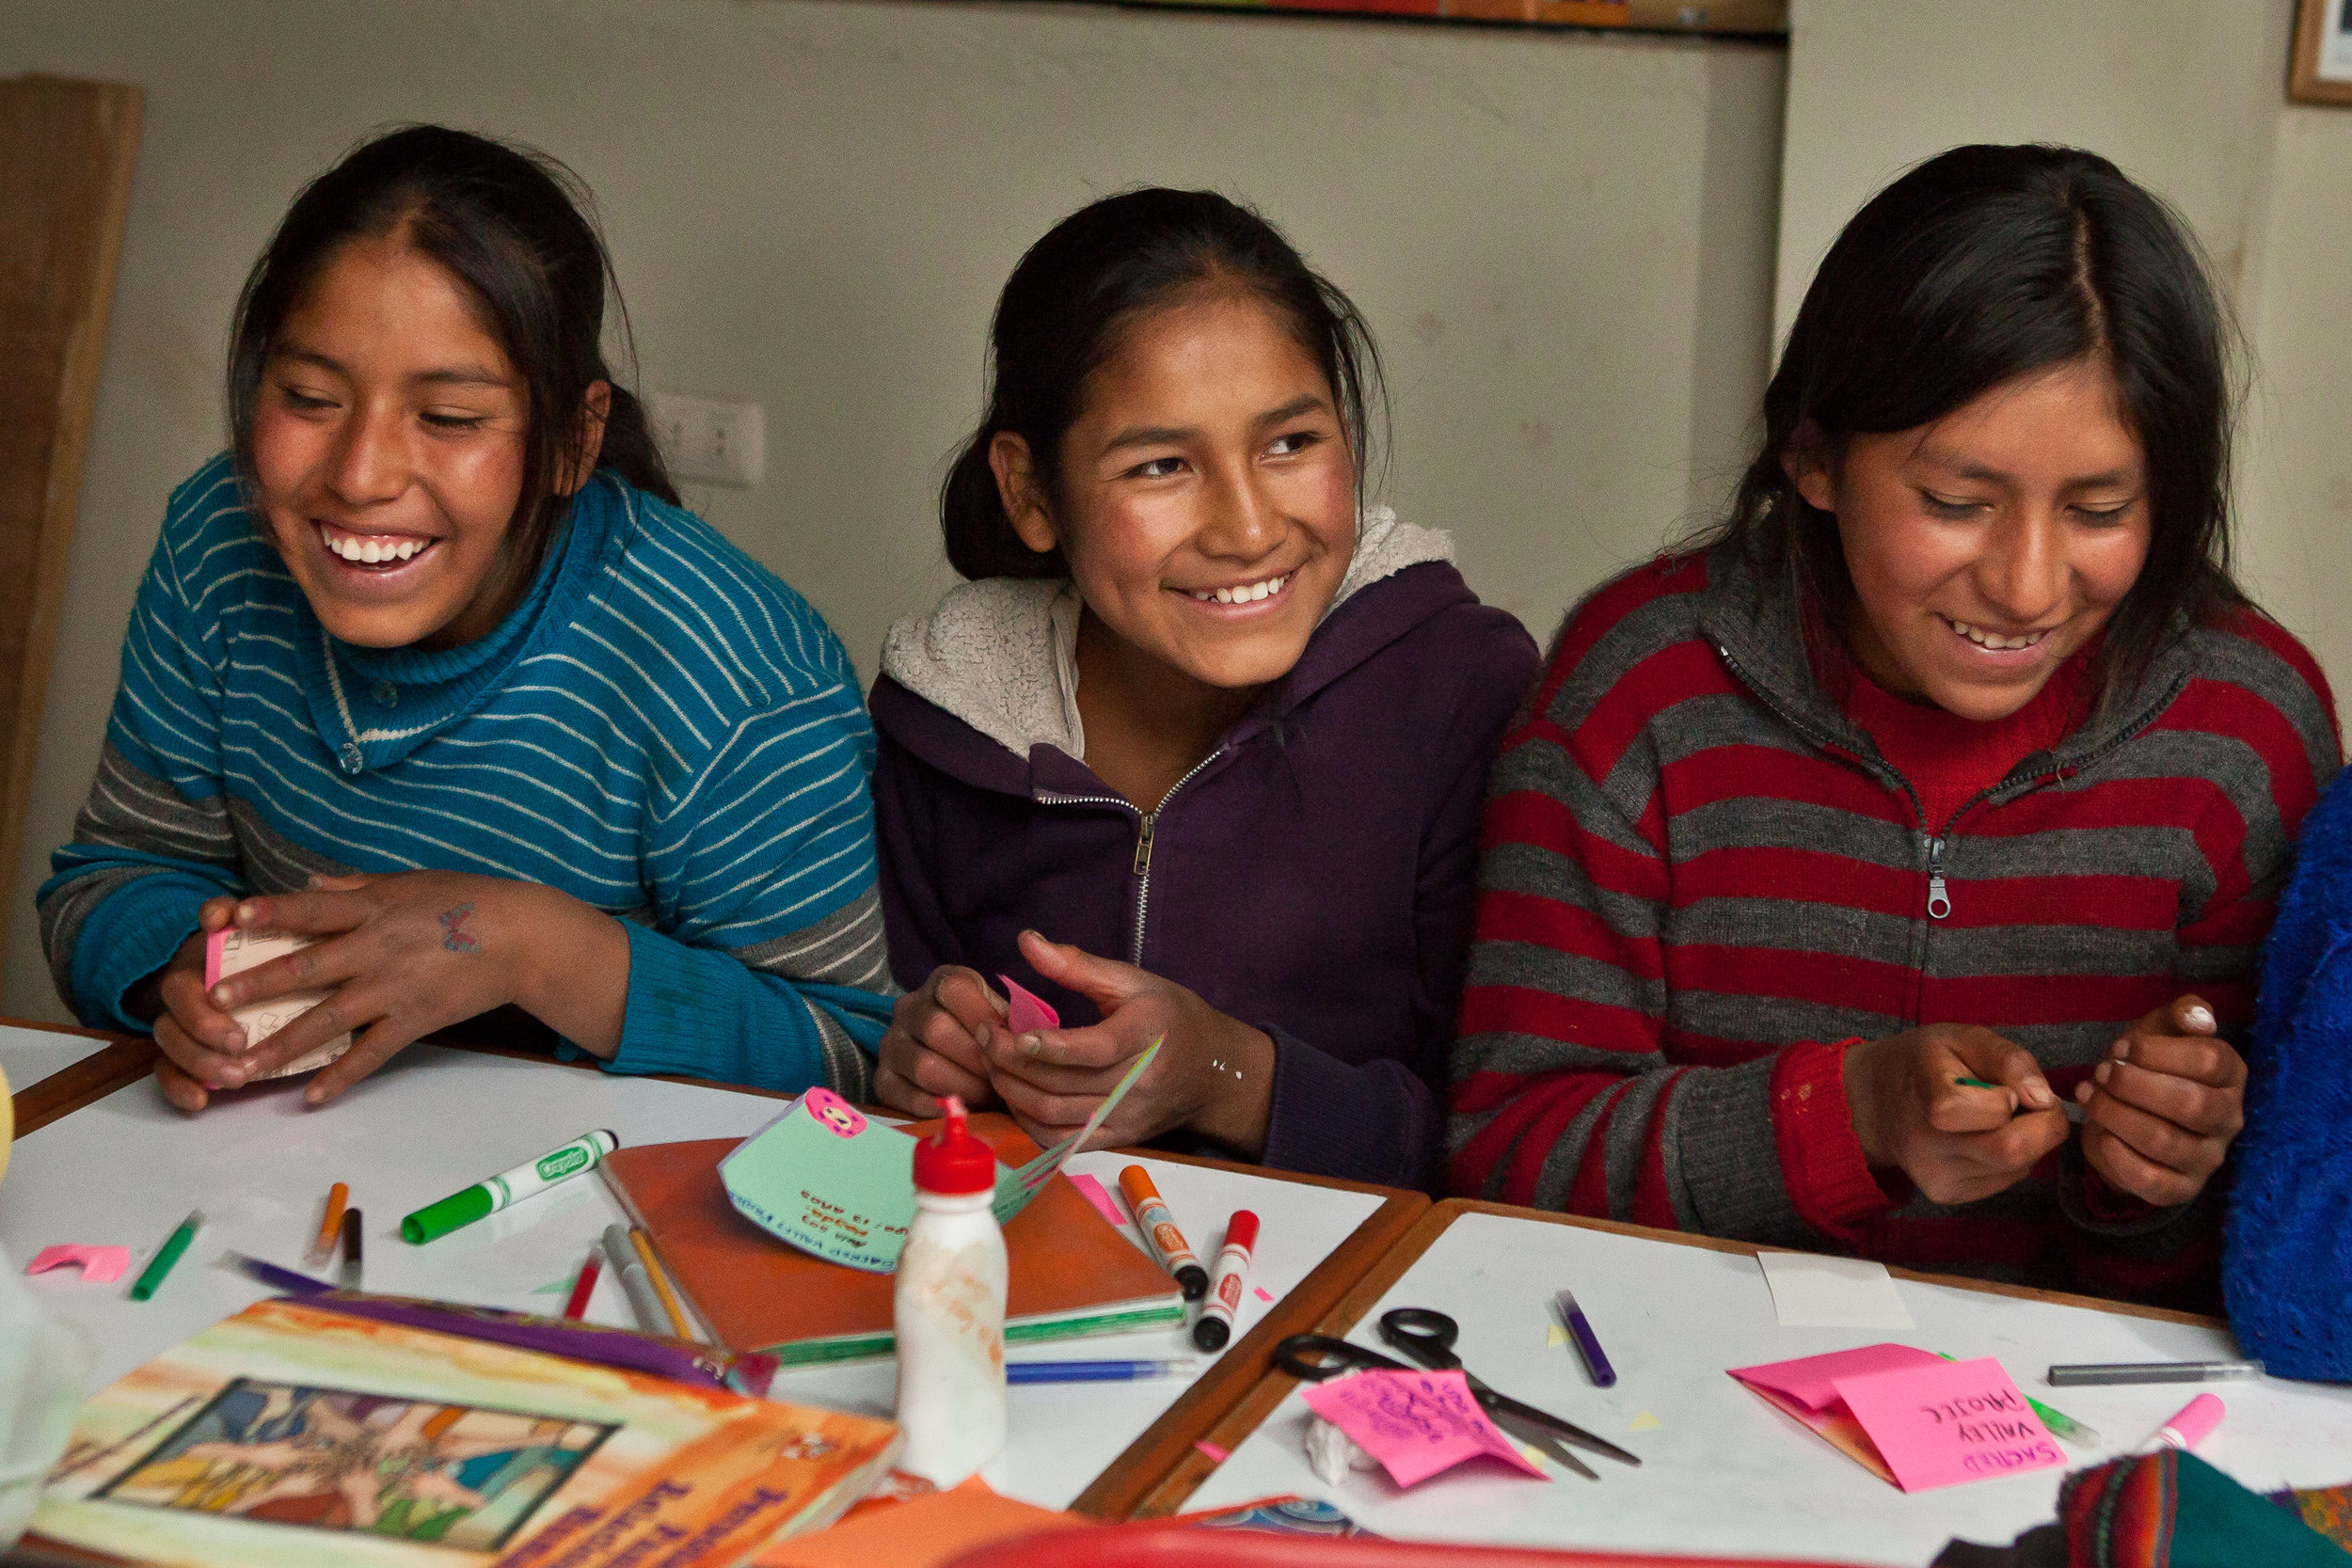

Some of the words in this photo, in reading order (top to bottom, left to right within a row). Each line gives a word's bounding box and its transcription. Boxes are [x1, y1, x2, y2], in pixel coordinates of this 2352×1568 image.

[539, 1148, 585, 1179] Crayola
[1959, 1421, 2037, 1443] VALLEY
[1963, 1441, 2058, 1473] SACRED
